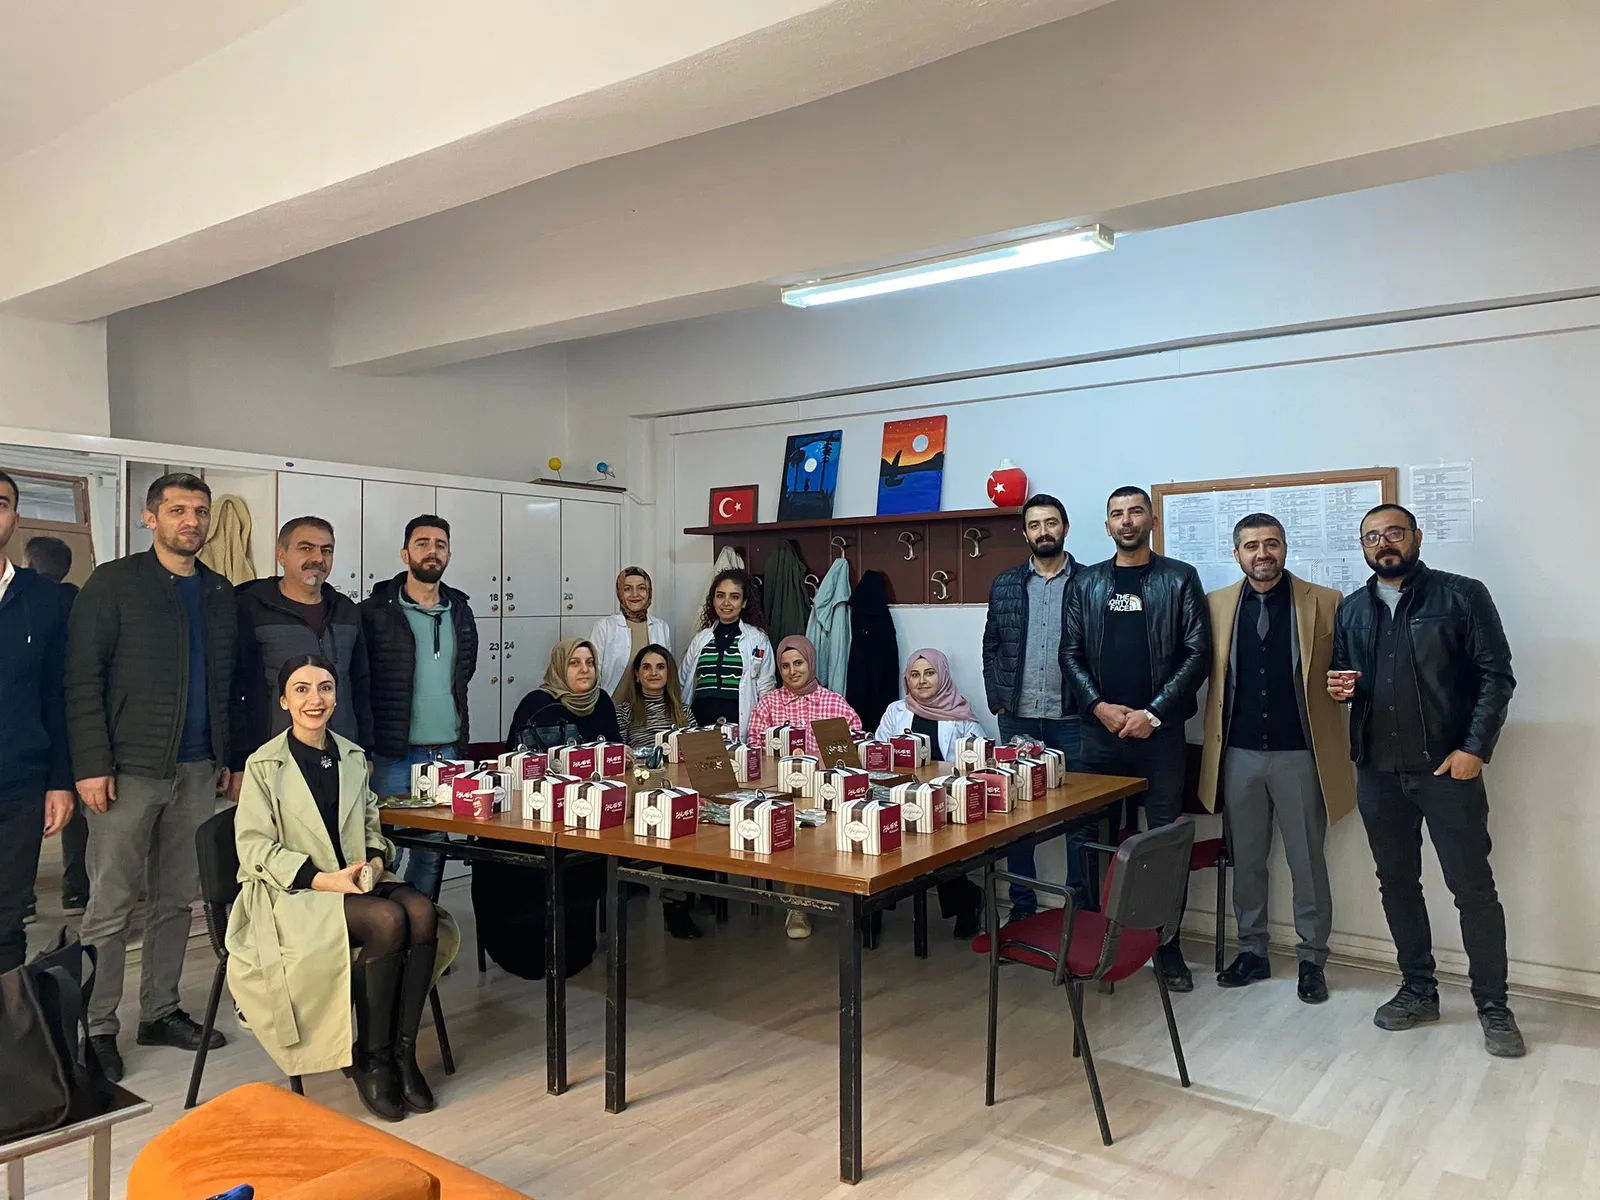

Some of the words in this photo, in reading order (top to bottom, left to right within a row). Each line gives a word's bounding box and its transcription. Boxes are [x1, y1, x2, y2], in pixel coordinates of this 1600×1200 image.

[489, 593, 499, 601] 18
[505, 592, 514, 600] 19
[489, 643, 500, 651] 23
[504, 641, 515, 650] 24
